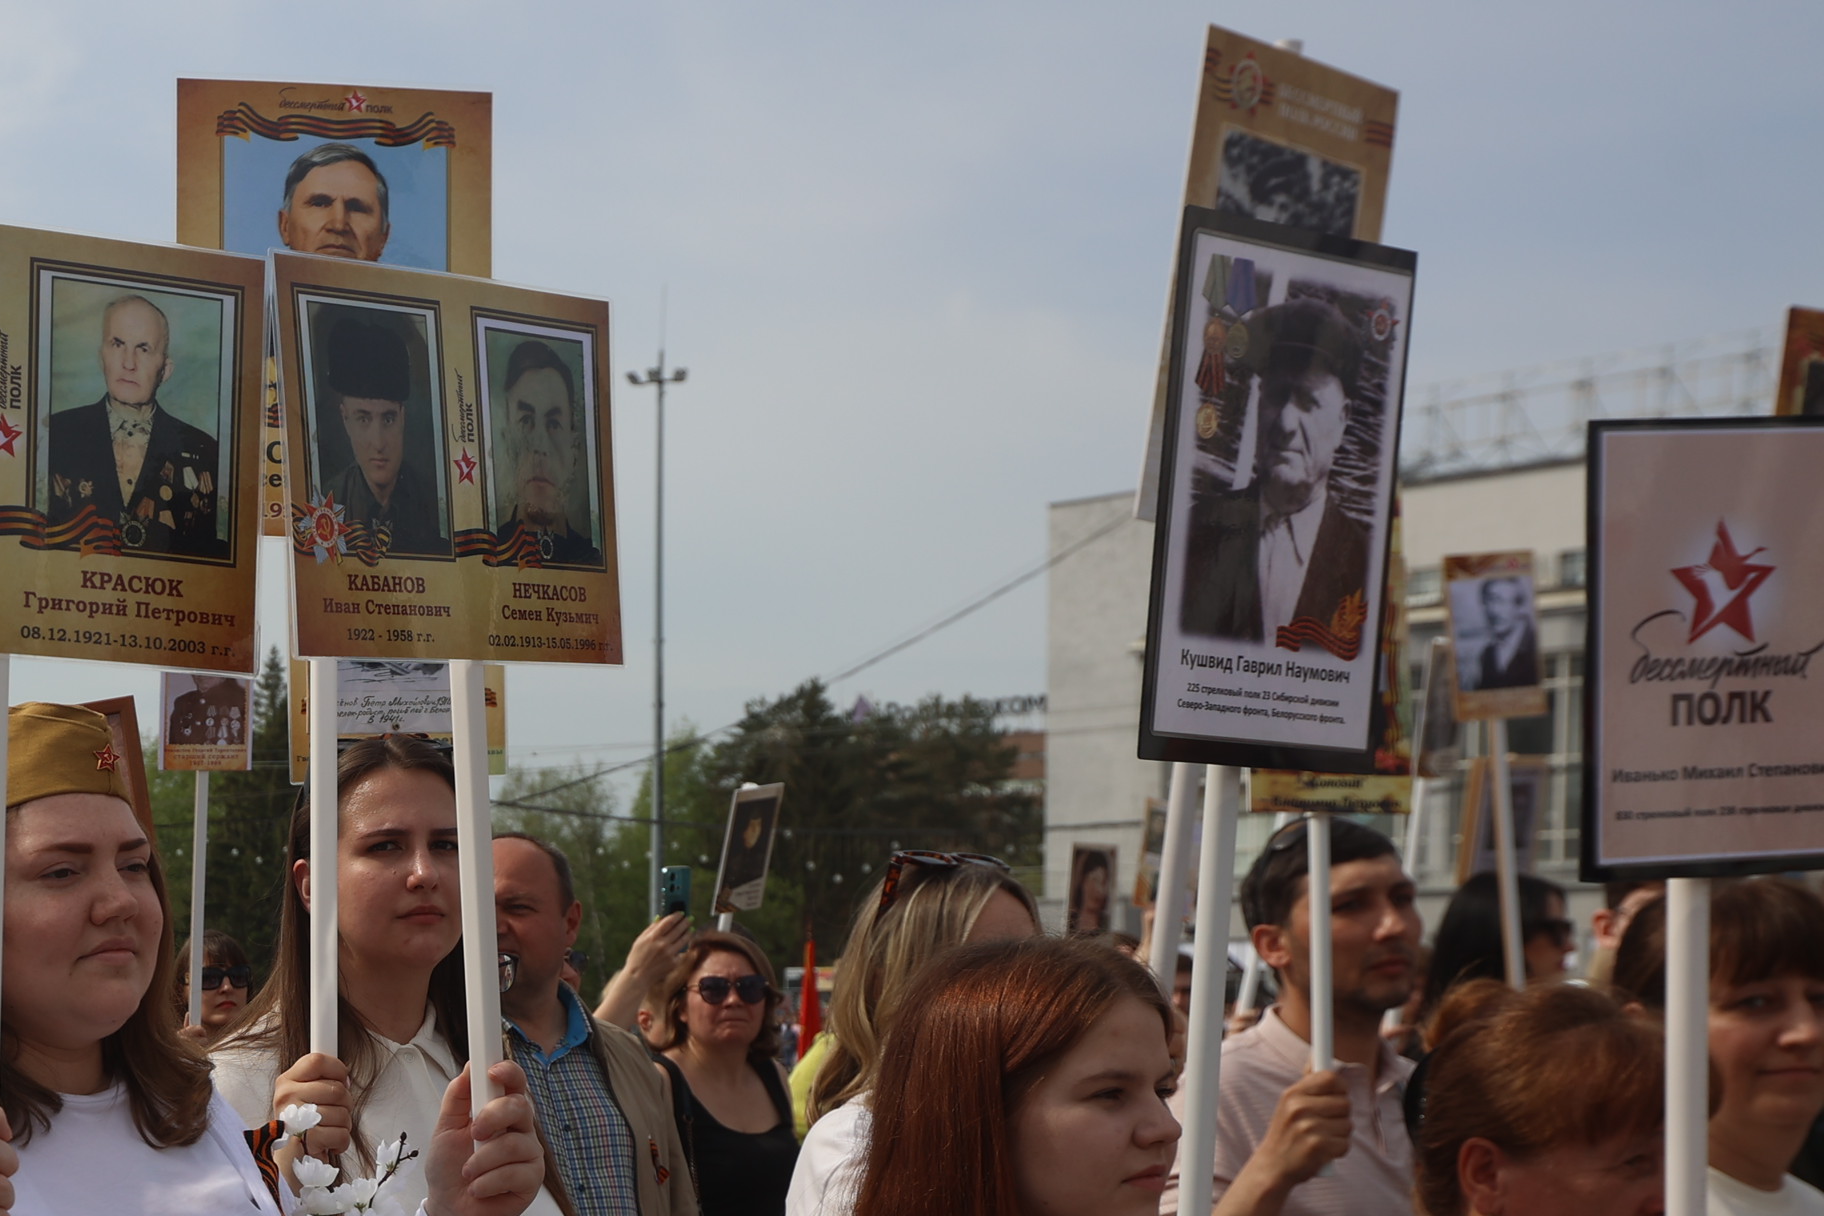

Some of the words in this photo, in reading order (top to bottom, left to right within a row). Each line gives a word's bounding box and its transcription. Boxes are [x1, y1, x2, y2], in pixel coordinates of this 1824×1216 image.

[10, 365, 22, 409] ПОЛК
[465, 403, 475, 442] ПОЛК
[81, 570, 183, 597] КРАСЮК
[347, 574, 426, 594] КАБАНОВ
[512, 582, 587, 602] НЕЧКАСОВ
[24, 591, 127, 618] Григорий
[135, 601, 236, 627] Петрович
[323, 598, 361, 615] Иван
[365, 599, 451, 618] Степанович
[502, 604, 542, 621] Семен
[546, 608, 599, 625] Кузьмич
[20, 625, 206, 654] 08.12.1921-13.10.2003
[210, 646, 236, 657] г.г.
[346, 628, 375, 642] 1922
[386, 629, 413, 642] 1958
[416, 633, 435, 643] г.г.
[488, 634, 596, 651] 02.02.1913-15.05.1996
[1180, 649, 1232, 673] Кушвид
[1236, 656, 1282, 677] Гаврил
[1286, 661, 1350, 683] Наумович
[1244, 691, 1261, 699] полк
[1670, 690, 1773, 726] ПОЛК
[1612, 769, 1679, 783] Иванько
[1682, 765, 1743, 780] Михаил
